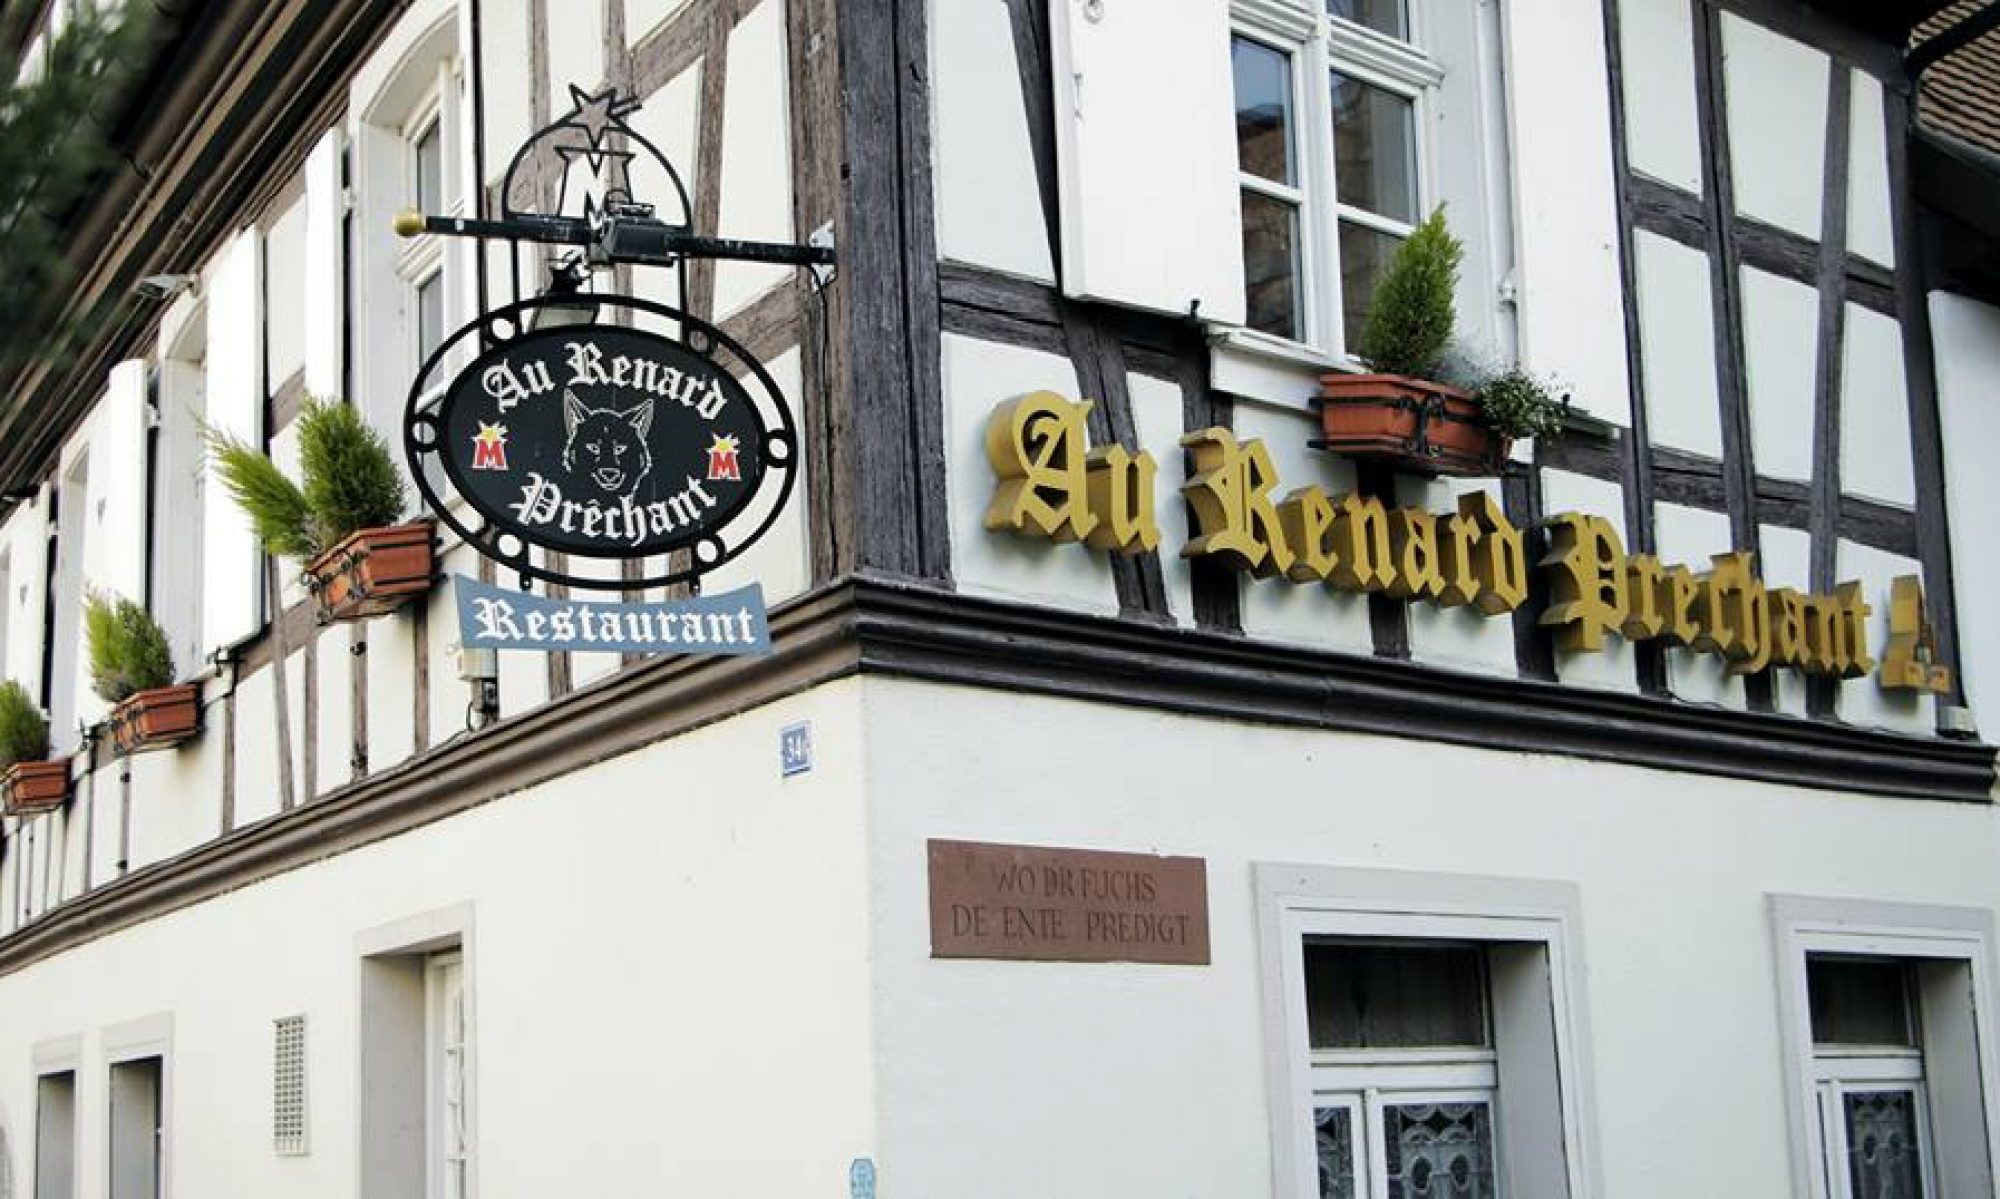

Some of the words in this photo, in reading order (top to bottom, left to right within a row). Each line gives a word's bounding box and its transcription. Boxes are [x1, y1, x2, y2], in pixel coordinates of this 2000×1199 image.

[481, 358, 555, 413] Au
[563, 341, 728, 420] Renard
[472, 436, 508, 470] M
[707, 451, 741, 480] M
[507, 471, 718, 546] Prêchant
[985, 390, 1162, 553] Au
[1179, 426, 1528, 614] Renard
[1537, 511, 1874, 675] Prechant
[471, 597, 757, 644] Restaurant
[999, 864, 1035, 894] WO
[1080, 867, 1156, 901] FUCHS
[951, 904, 988, 937] DE
[1002, 906, 1068, 940] ENTE
[1086, 910, 1190, 946] PREDIGT
